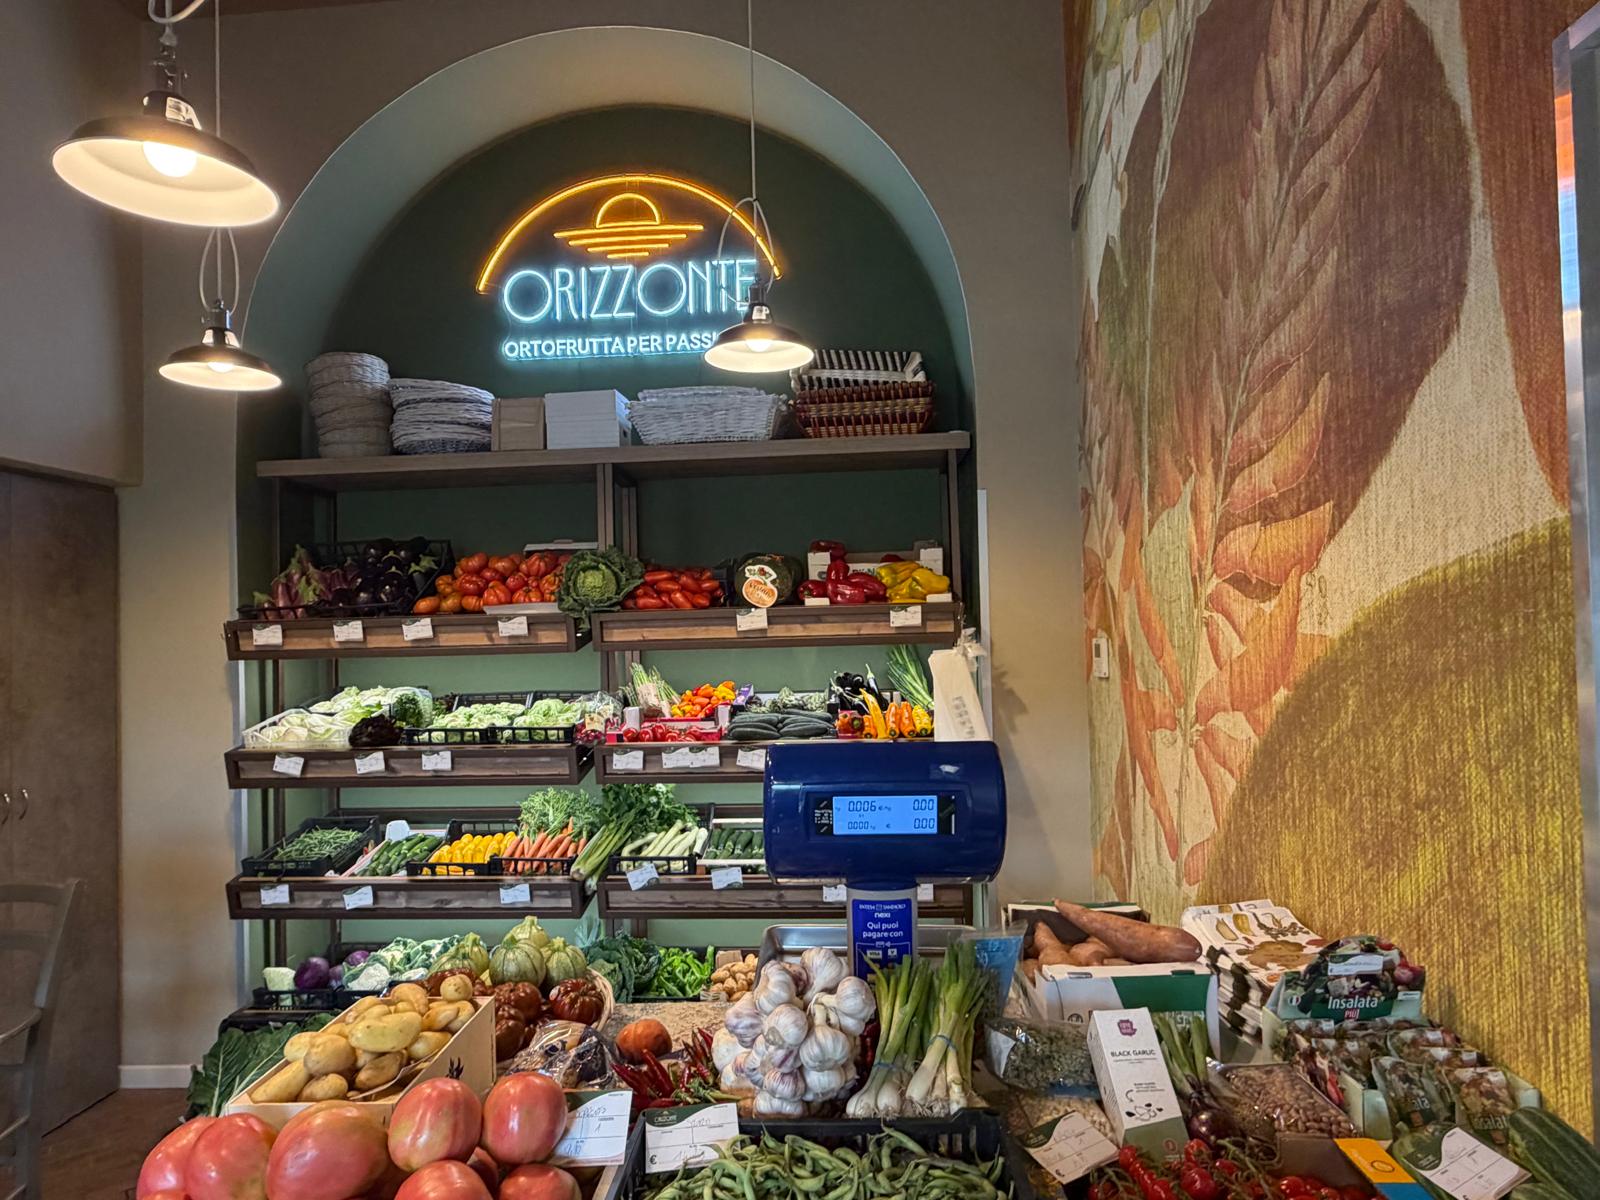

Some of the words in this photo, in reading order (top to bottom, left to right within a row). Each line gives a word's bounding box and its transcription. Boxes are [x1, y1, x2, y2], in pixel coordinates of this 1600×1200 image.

[503, 259, 757, 322] ORIZZONTE
[504, 336, 624, 357] ORTOFRUTTA
[627, 335, 662, 352] PER
[866, 922, 881, 930] Qui
[881, 921, 899, 930] puoi
[862, 931, 889, 939] pagare
[889, 930, 904, 938] con
[1328, 995, 1378, 1010] Insalata
[1110, 1050, 1132, 1058] BLACK
[1132, 1049, 1157, 1057] GARLIC
[649, 1154, 658, 1166] €
